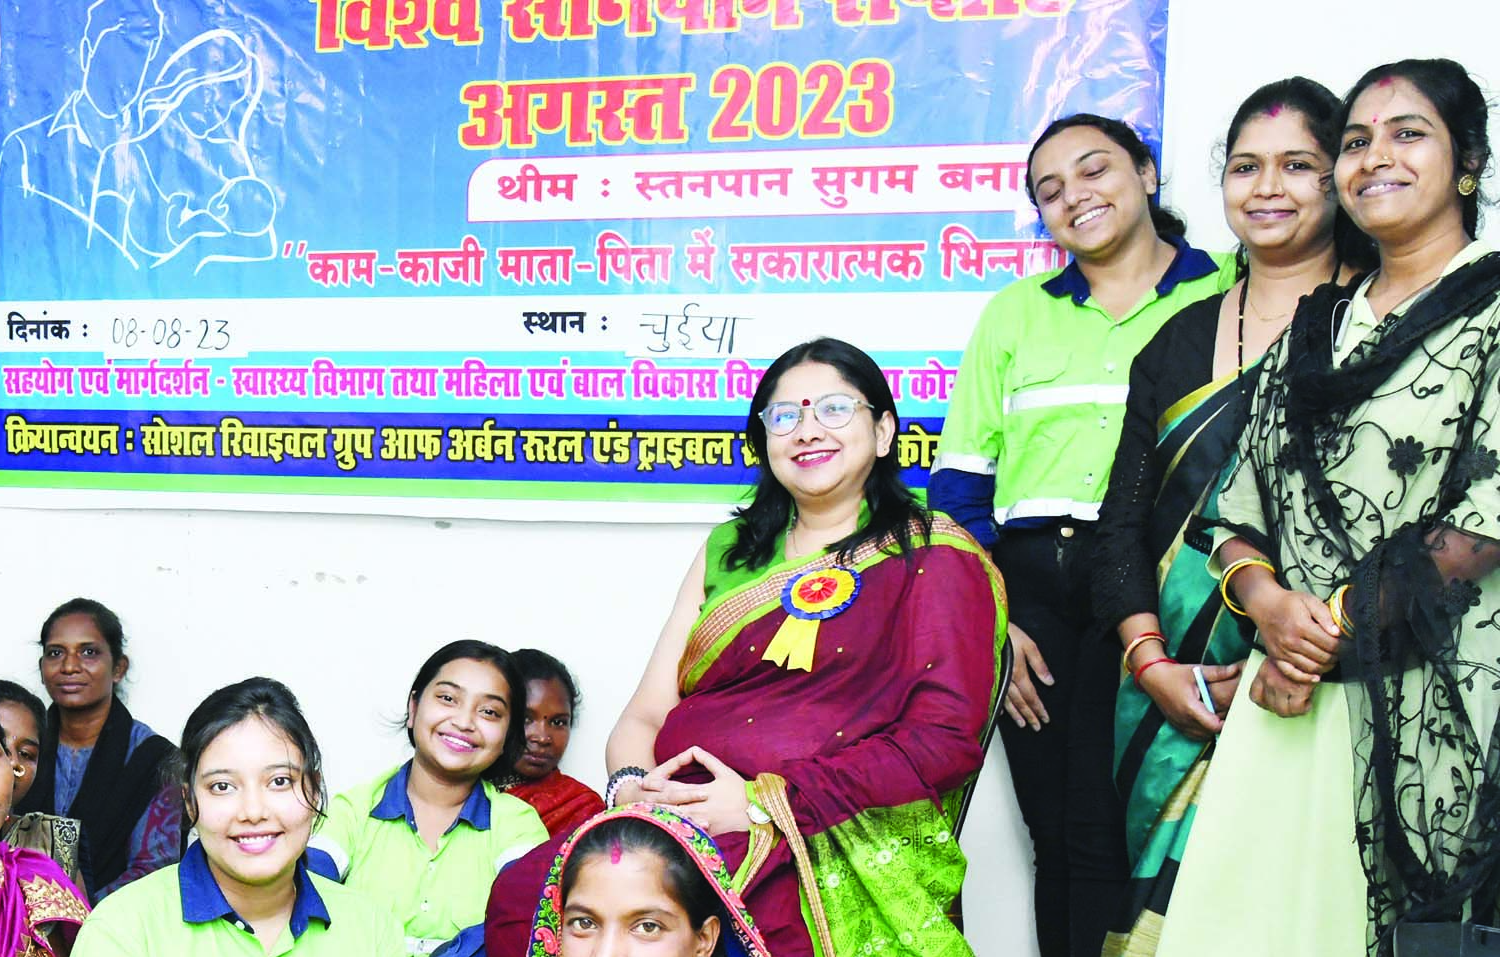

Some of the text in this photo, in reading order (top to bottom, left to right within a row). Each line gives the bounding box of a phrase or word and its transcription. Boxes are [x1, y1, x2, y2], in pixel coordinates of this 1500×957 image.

[459, 58, 895, 150] अगस्त 2023
[497, 163, 578, 203] थीम
[634, 166, 794, 201] स्तनपान
[811, 163, 919, 209] सुगम
[938, 160, 1028, 192] बना
[496, 231, 675, 286] माता-पिता
[686, 226, 717, 283] में
[728, 241, 927, 284] सकारात्मक
[7, 311, 71, 343] दिनांक
[111, 317, 232, 351] 08-08-23
[522, 311, 587, 335] स्थान
[3, 359, 75, 397] सहयोग
[78, 359, 113, 396] एवं
[114, 359, 210, 397] मार्गदर्शन
[312, 359, 386, 398] विभाग
[390, 367, 439, 398] तथा
[443, 359, 523, 399] महिला
[527, 359, 569, 399] एवं
[572, 367, 627, 399] बाल
[631, 358, 719, 400] विकास
[4, 414, 120, 457] क्रियान्वयन
[140, 417, 217, 456] सोशल
[219, 417, 328, 464] रिवाइवल
[380, 427, 444, 462] आफ
[447, 419, 517, 463] अर्बन
[589, 419, 634, 464] एंड
[636, 430, 736, 472] ट्राइबल
